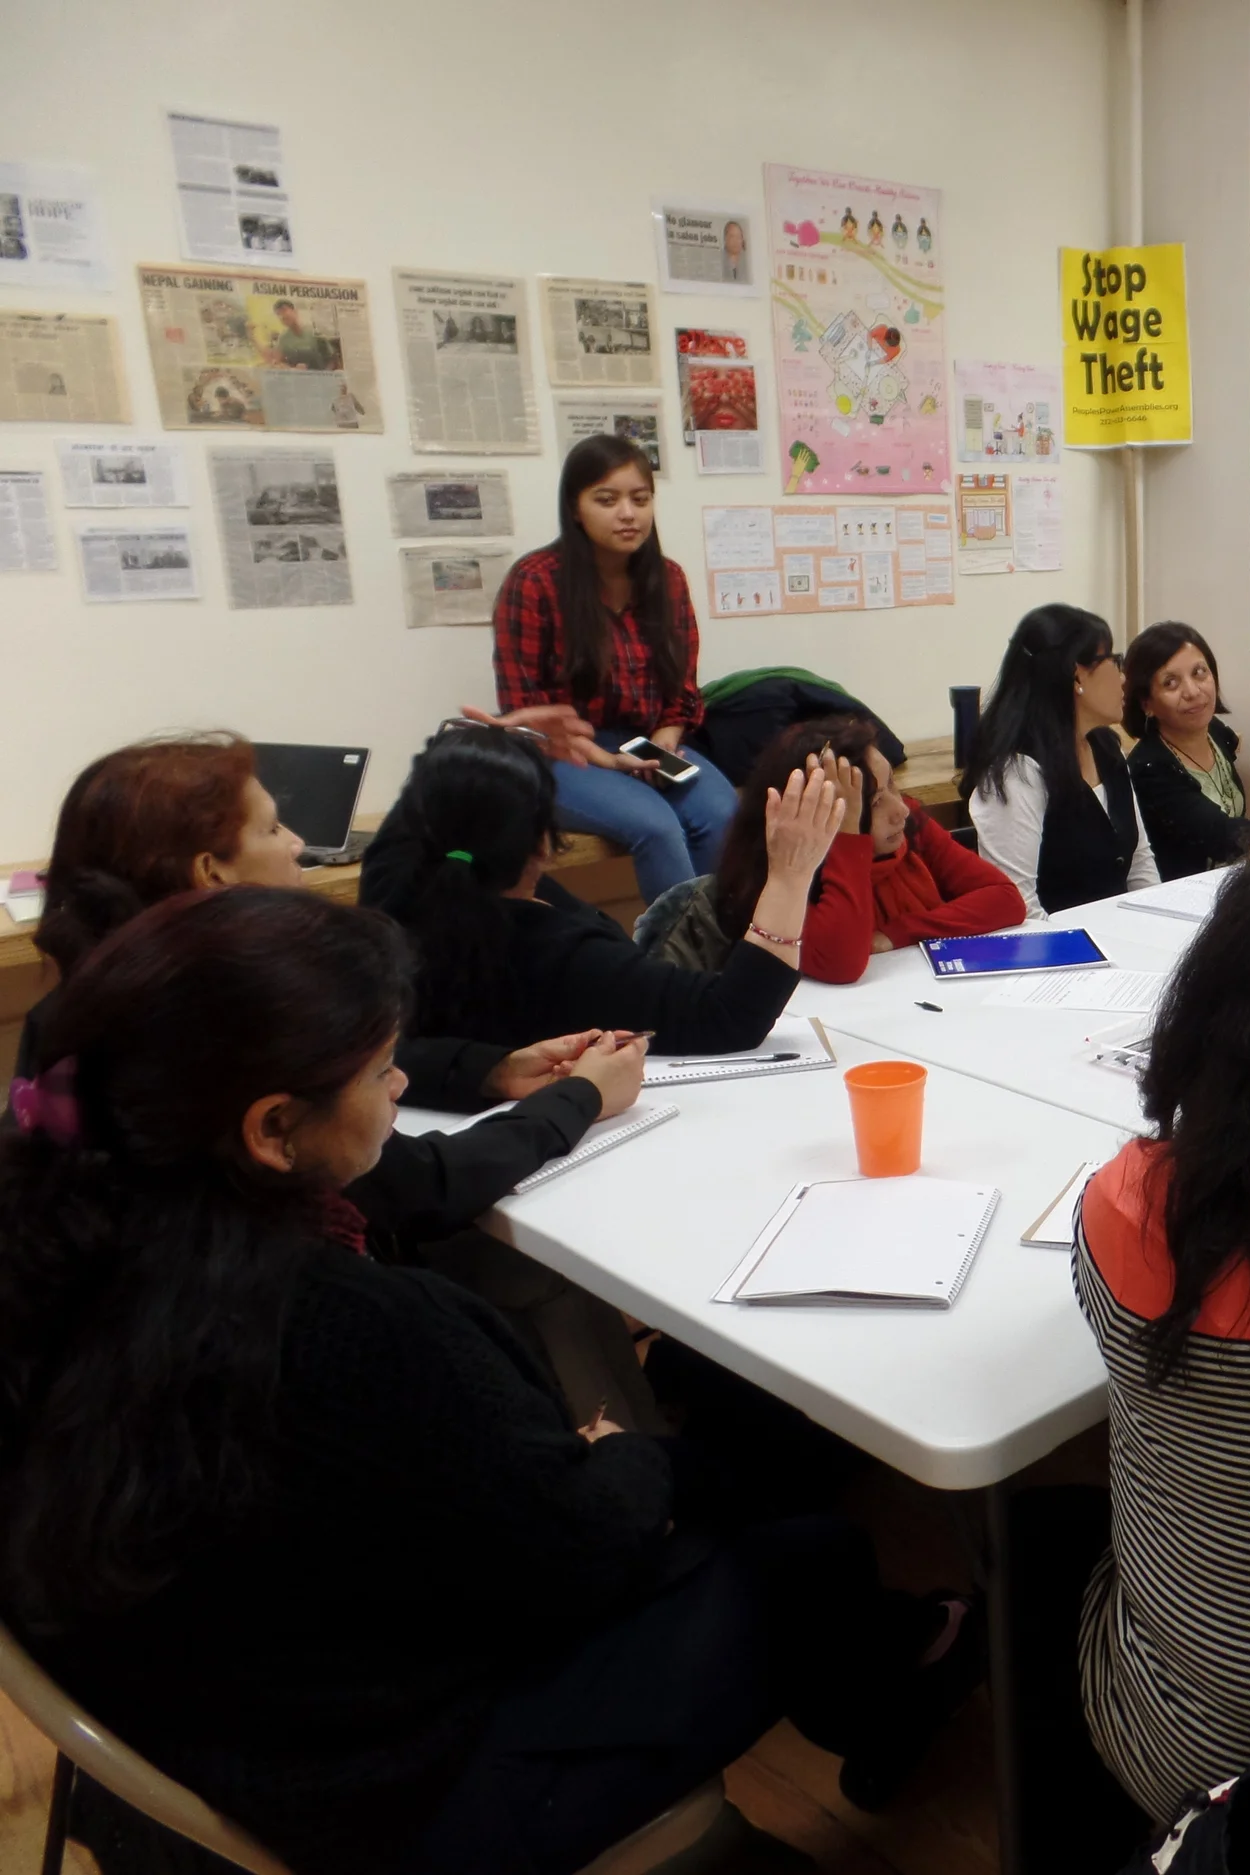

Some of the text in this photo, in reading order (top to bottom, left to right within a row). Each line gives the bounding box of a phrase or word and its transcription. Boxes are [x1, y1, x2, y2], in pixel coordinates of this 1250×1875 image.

[678, 216, 712, 229] glamour
[700, 232, 718, 243] jobs
[142, 274, 359, 301] NEPAL GAINING ASIAN PERSUASION
[1081, 252, 1146, 301] Stop
[1072, 299, 1162, 343] Wage
[1080, 347, 1164, 395] Theft
